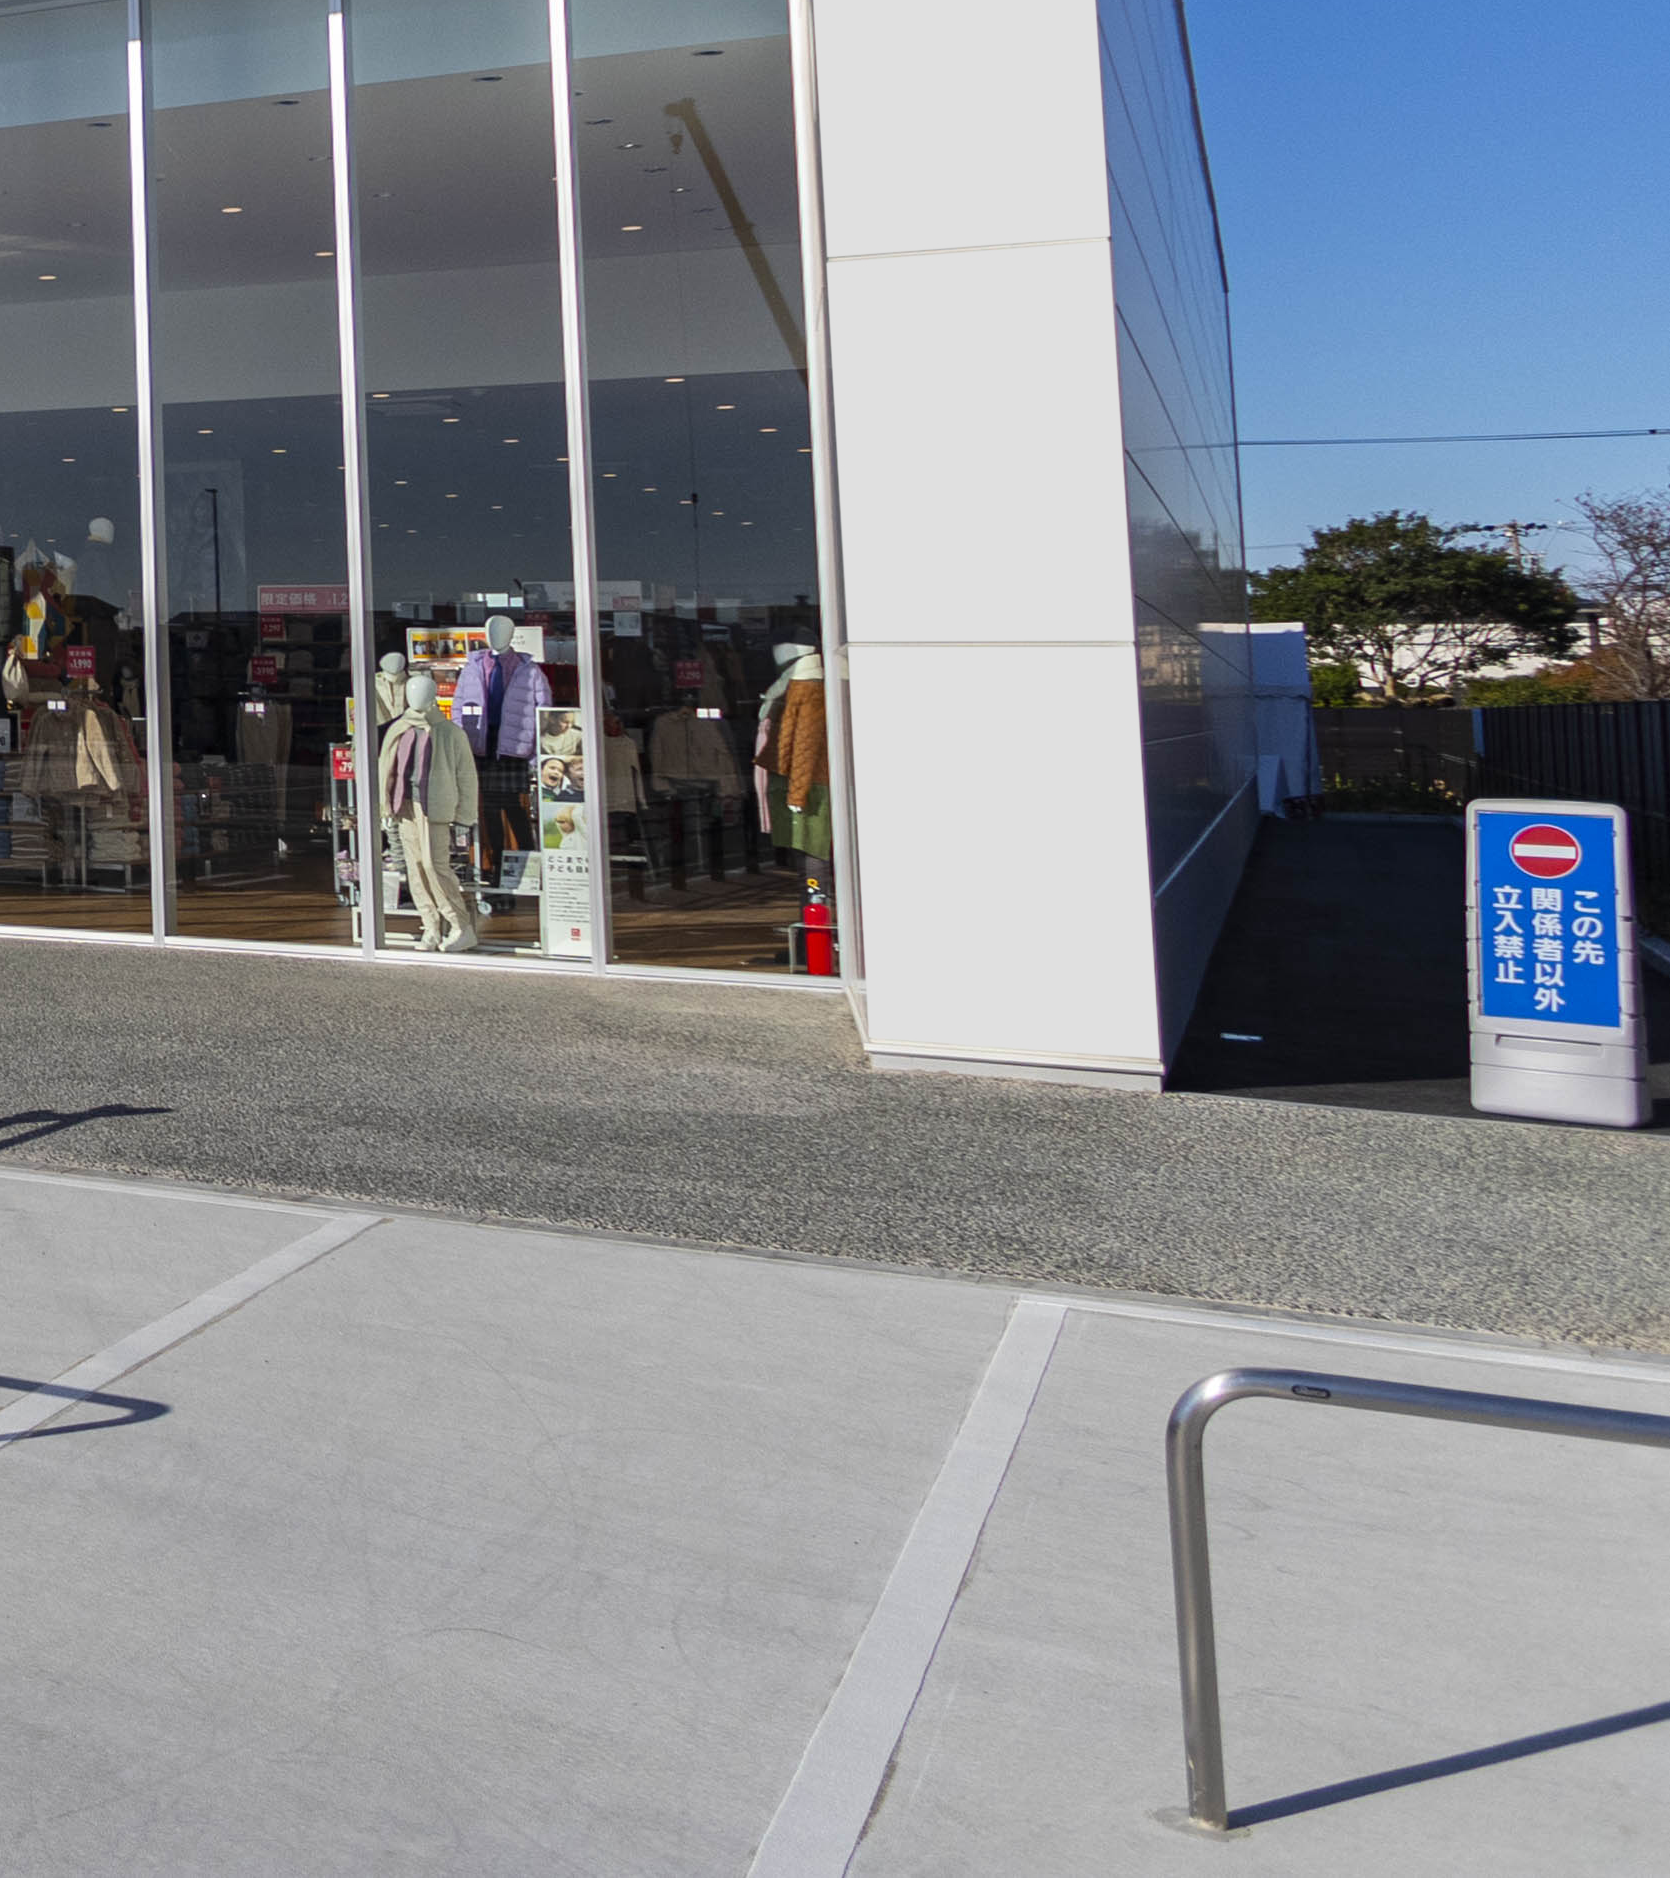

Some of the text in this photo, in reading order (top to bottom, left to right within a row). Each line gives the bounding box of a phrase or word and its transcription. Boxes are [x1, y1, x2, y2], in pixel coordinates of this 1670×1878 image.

[1491, 885, 1526, 984] 立入禁止
[1531, 887, 1566, 1013] 関係者以外
[1571, 890, 1606, 965] この先
